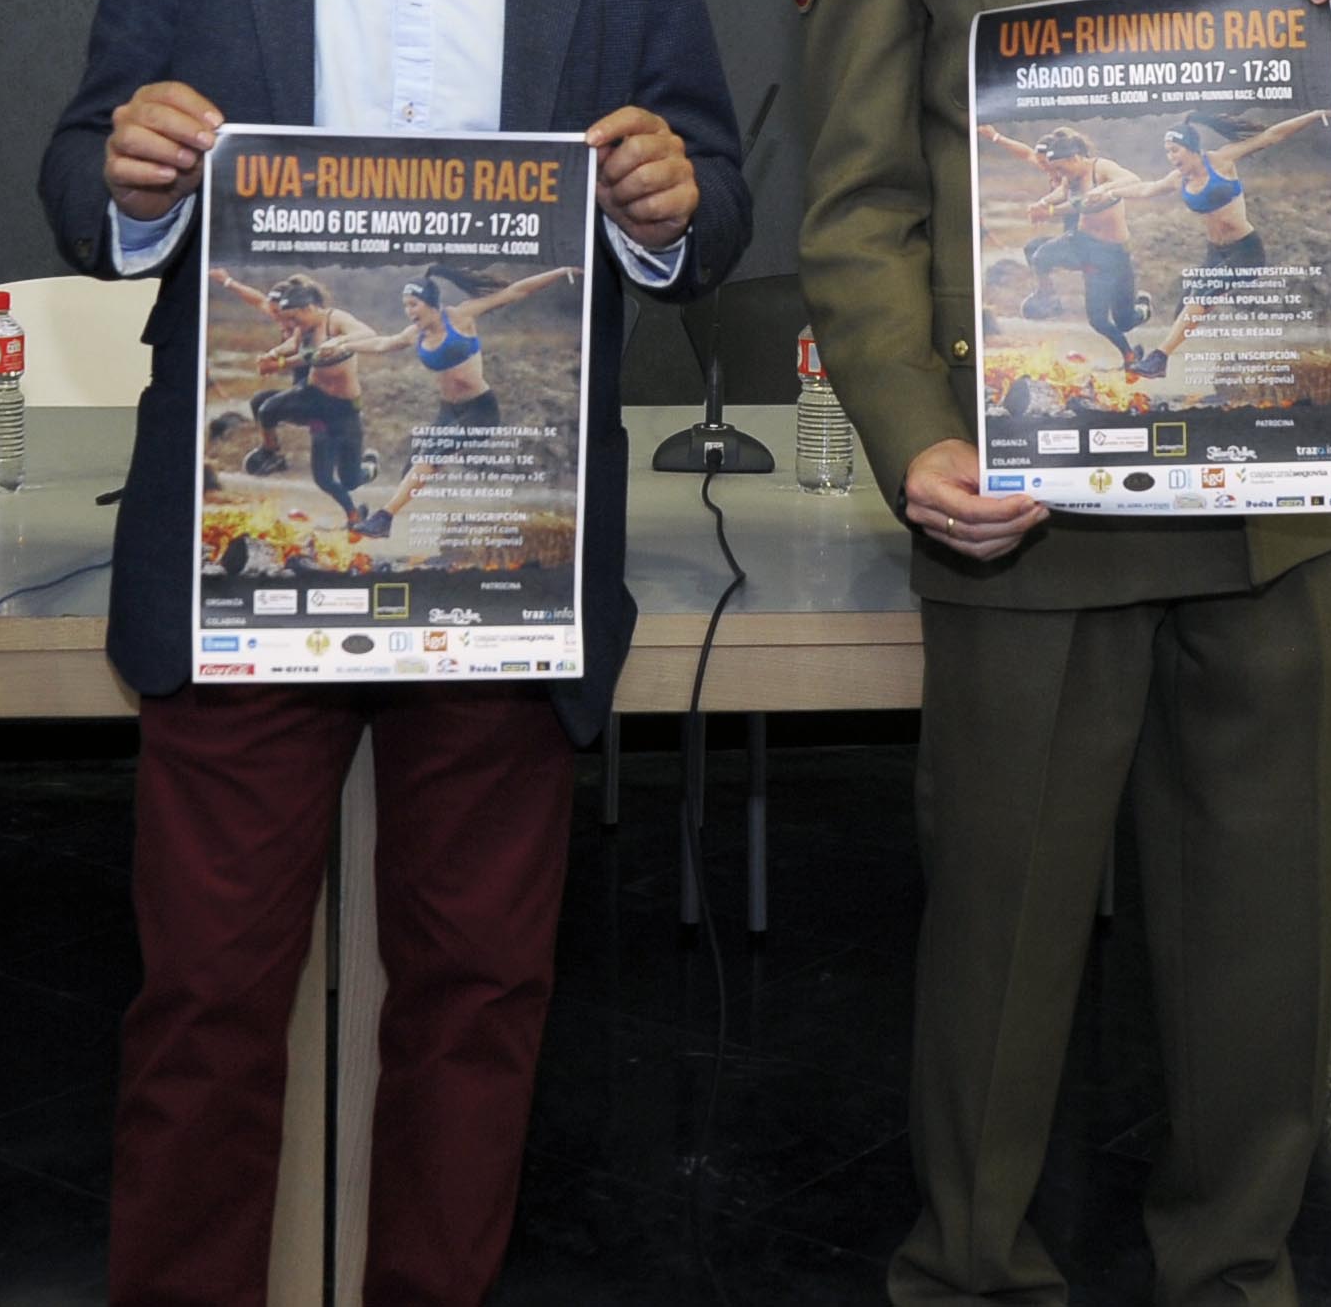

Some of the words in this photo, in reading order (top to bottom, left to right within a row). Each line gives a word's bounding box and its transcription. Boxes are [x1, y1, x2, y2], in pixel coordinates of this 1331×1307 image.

[999, 12, 1215, 57] UVA-RUNNING
[1223, 9, 1307, 50] RACE
[1016, 63, 1084, 89] SÁBADO
[1088, 65, 1100, 87] 6
[1103, 64, 1126, 87] DE
[1129, 61, 1177, 85] MAYO
[1181, 61, 1224, 85] 2017
[1242, 59, 1291, 83] 17:30
[1112, 91, 1148, 104] 8.000M
[1256, 87, 1292, 99] 4.000M
[236, 155, 466, 201] UVA-RUNNING
[474, 160, 559, 203] RACE
[252, 205, 324, 234] SÁBADO
[327, 210, 342, 234] 6
[344, 210, 368, 235] DE
[372, 211, 418, 235] MAYO
[425, 211, 472, 236] 2017
[489, 213, 539, 237] 17:30
[501, 241, 539, 255] 4.000M
[1182, 265, 1234, 277] CATEGORÍA
[1183, 293, 1234, 305] CATEGORÍA
[1270, 313, 1294, 323] mayo
[1184, 328, 1230, 339] CAMISETA
[1232, 329, 1244, 337] DE
[1246, 328, 1282, 337] REGALO
[1255, 419, 1294, 427] PATROCINA
[412, 424, 466, 437] CATEGORÍA
[412, 452, 464, 465] CATEGORÍA
